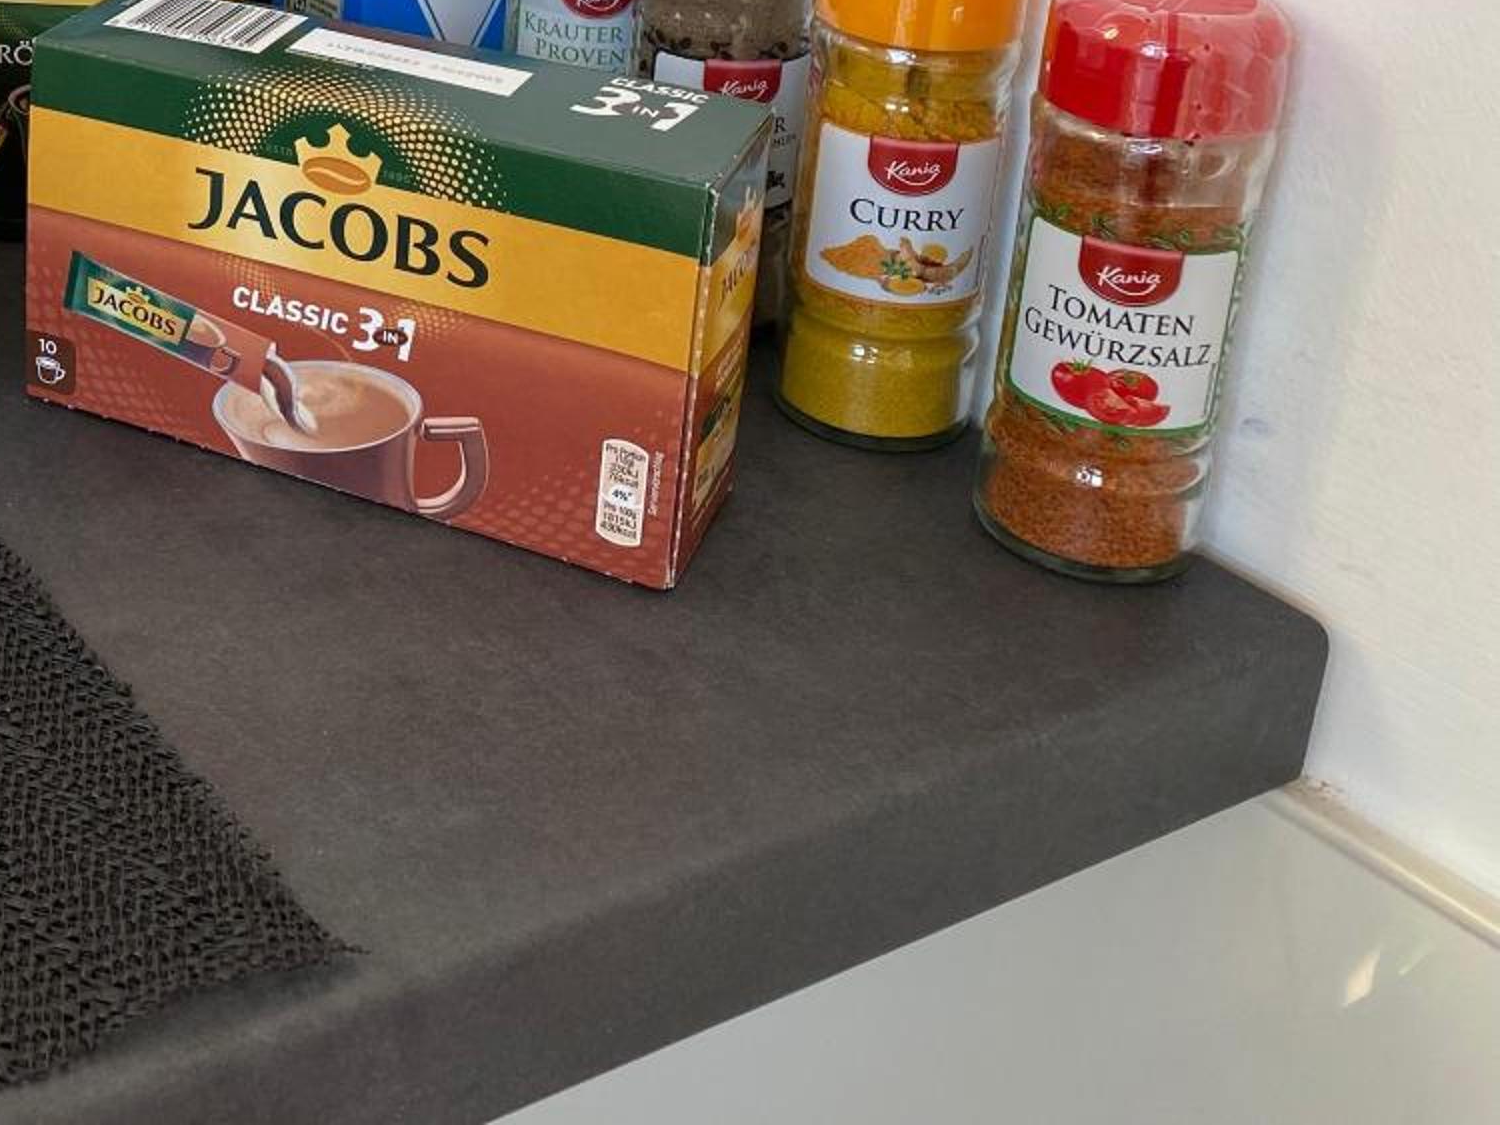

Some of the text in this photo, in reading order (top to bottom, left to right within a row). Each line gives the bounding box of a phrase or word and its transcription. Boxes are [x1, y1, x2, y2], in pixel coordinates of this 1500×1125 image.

[609, 76, 710, 104] CLASSIC
[885, 160, 941, 187] Kania
[186, 166, 490, 289] JACOBS
[849, 197, 965, 232] CURRY
[1097, 264, 1162, 297] Kania
[93, 285, 177, 337] JACOBS
[233, 286, 349, 334] CLASSIC
[1047, 283, 1195, 337] TOMATEN
[38, 338, 57, 355] 10
[1024, 306, 1212, 368] GEWÜRZSALZ
